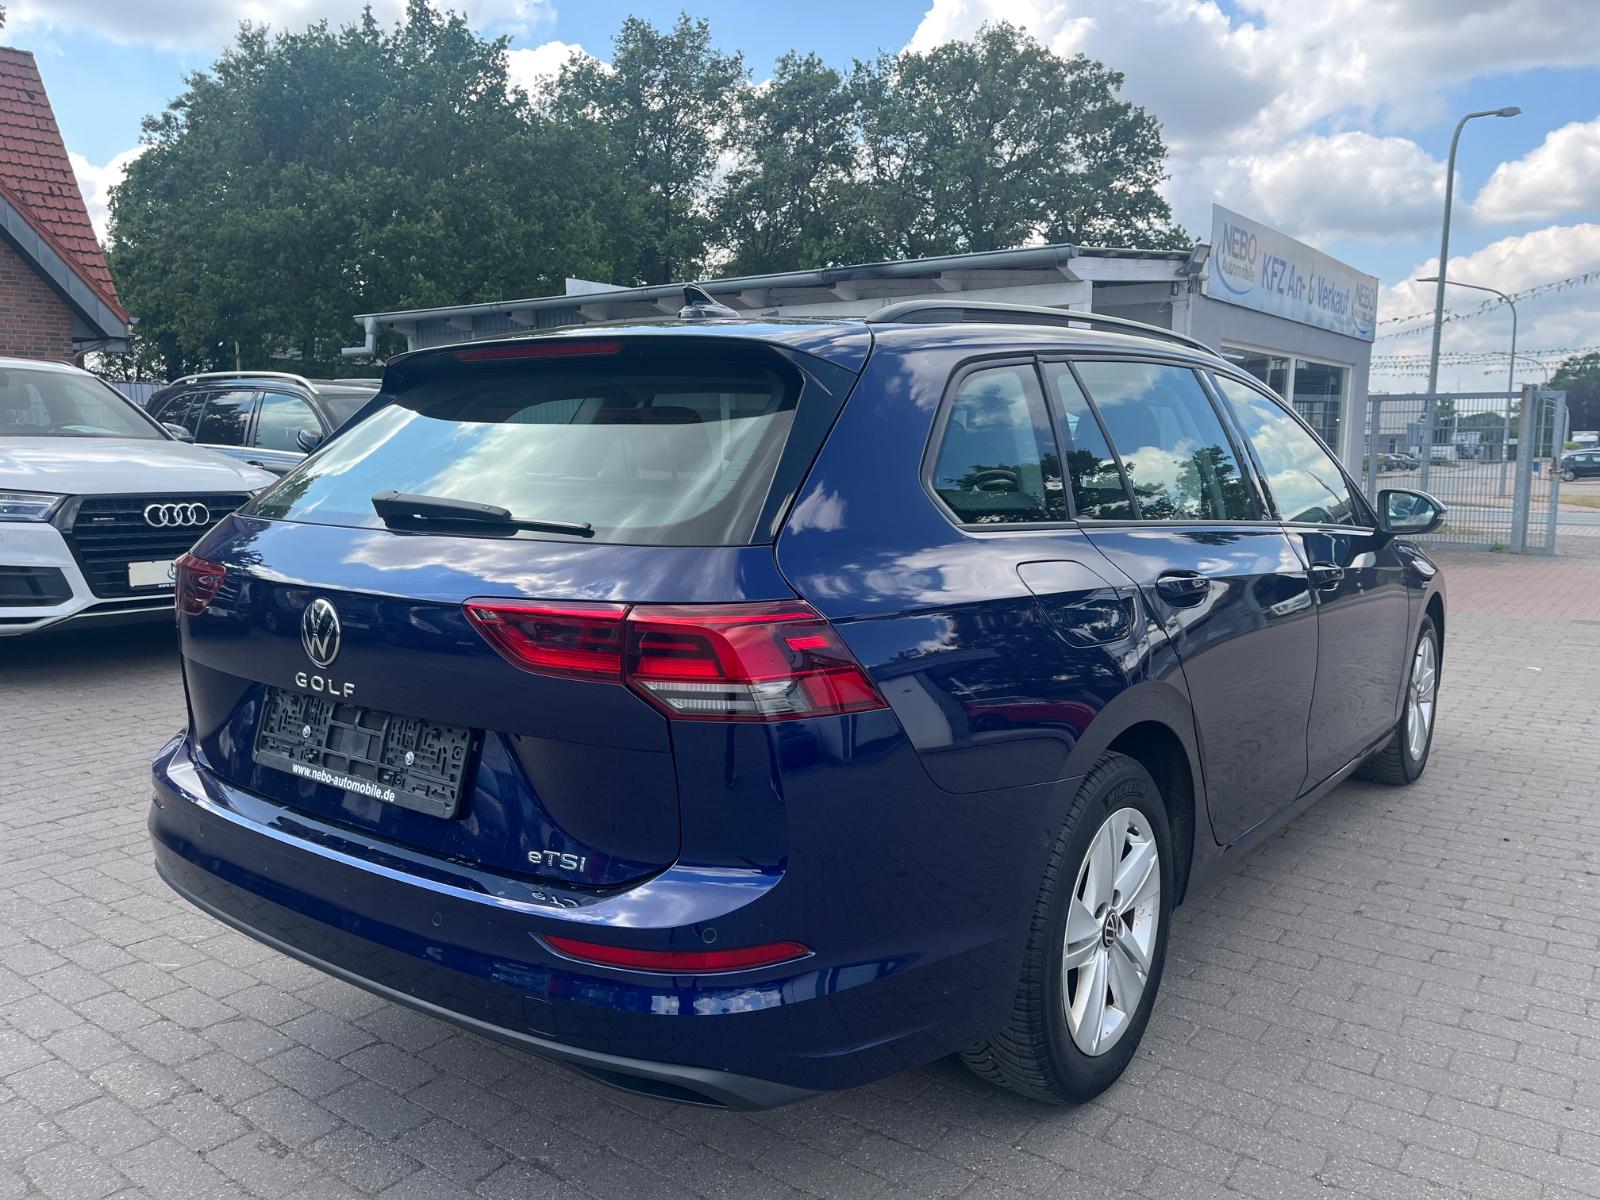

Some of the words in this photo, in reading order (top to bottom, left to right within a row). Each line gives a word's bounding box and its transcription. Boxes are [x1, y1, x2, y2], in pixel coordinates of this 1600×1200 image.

[1222, 222, 1257, 266] NEBO
[1221, 256, 1256, 283] Automobile
[1261, 252, 1288, 295] KFZ
[1287, 265, 1307, 301] An-
[1317, 274, 1351, 316] Verkauf
[1355, 282, 1375, 311] NEBO
[295, 671, 356, 698] GOLF
[292, 762, 396, 802] www.nebo-automobile.de
[527, 849, 587, 873] eTSI
